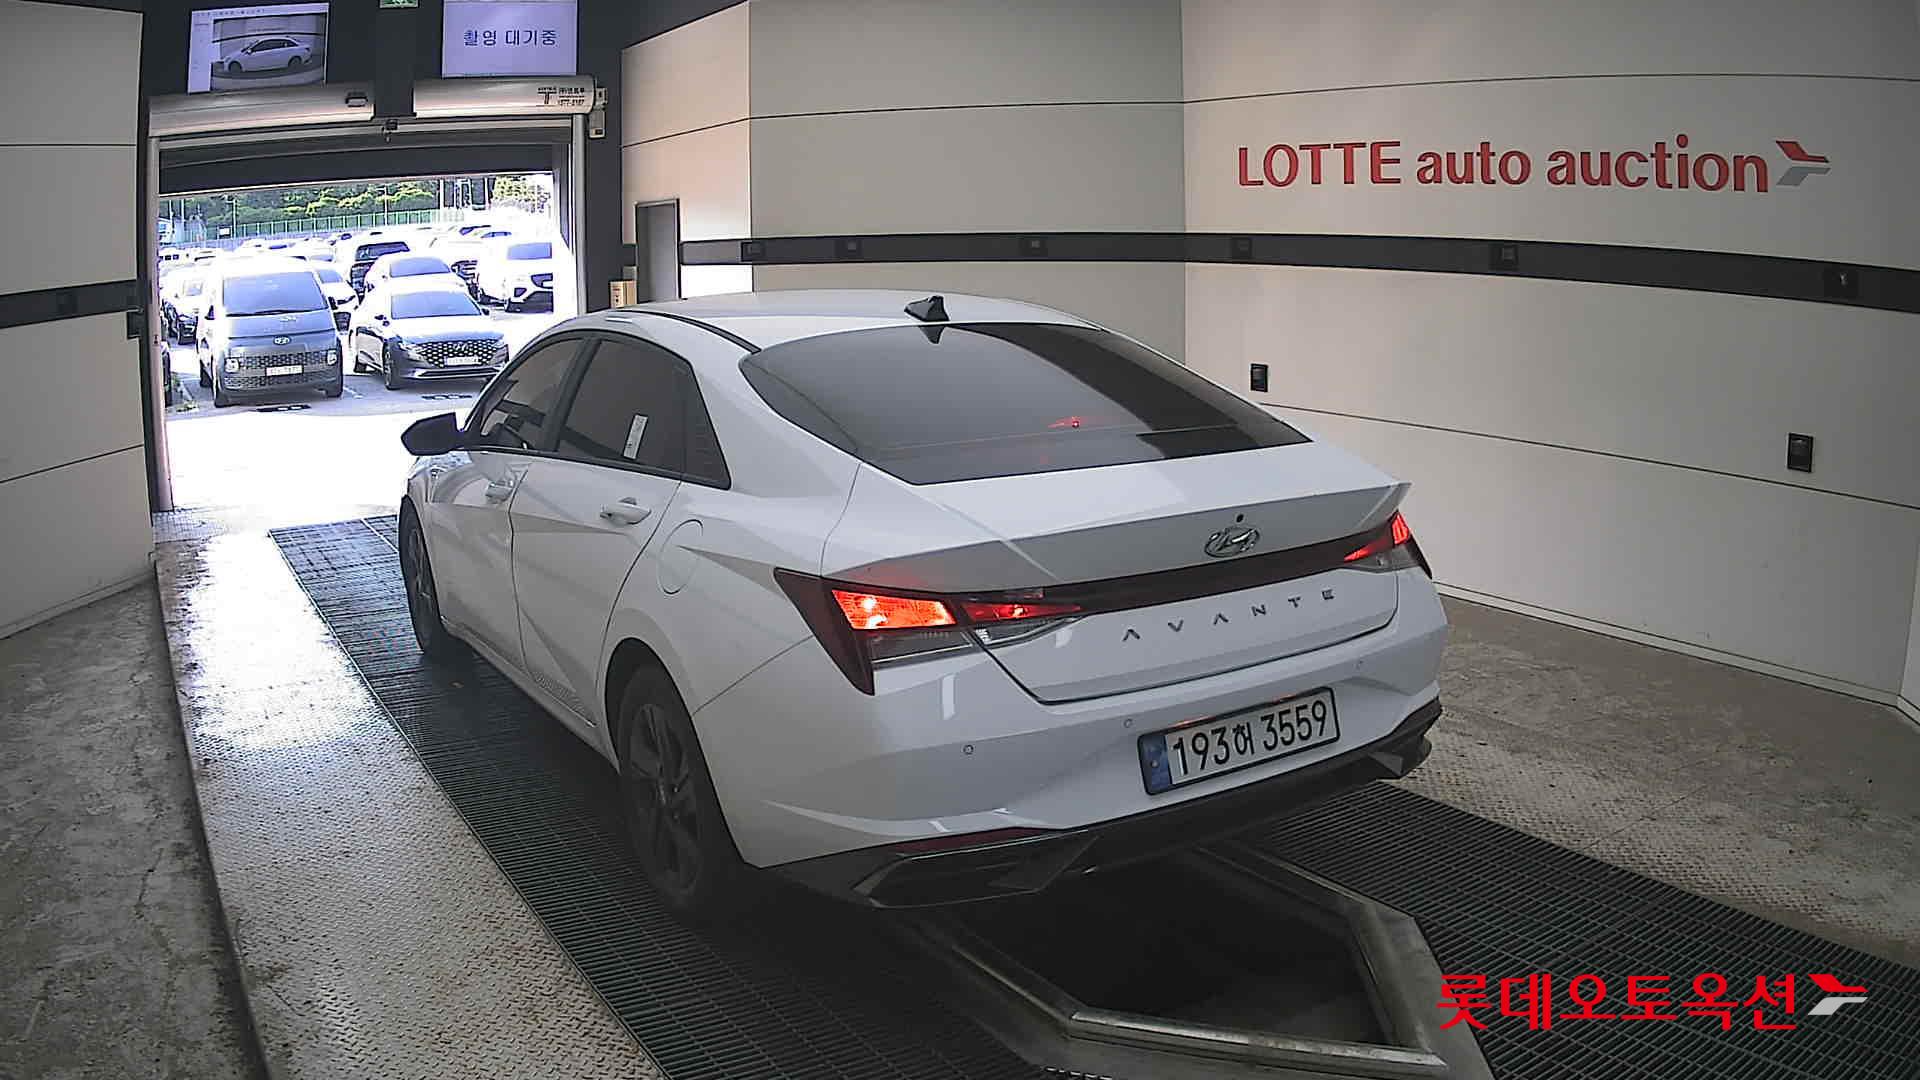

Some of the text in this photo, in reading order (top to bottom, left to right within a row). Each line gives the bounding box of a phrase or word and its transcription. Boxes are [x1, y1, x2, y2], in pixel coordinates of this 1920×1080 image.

[463, 29, 557, 46] 촬영 대기중
[1238, 134, 1768, 192] LOTTE auto auction
[1122, 588, 1335, 642] AVANTE
[1173, 699, 1327, 775] 193허 3559
